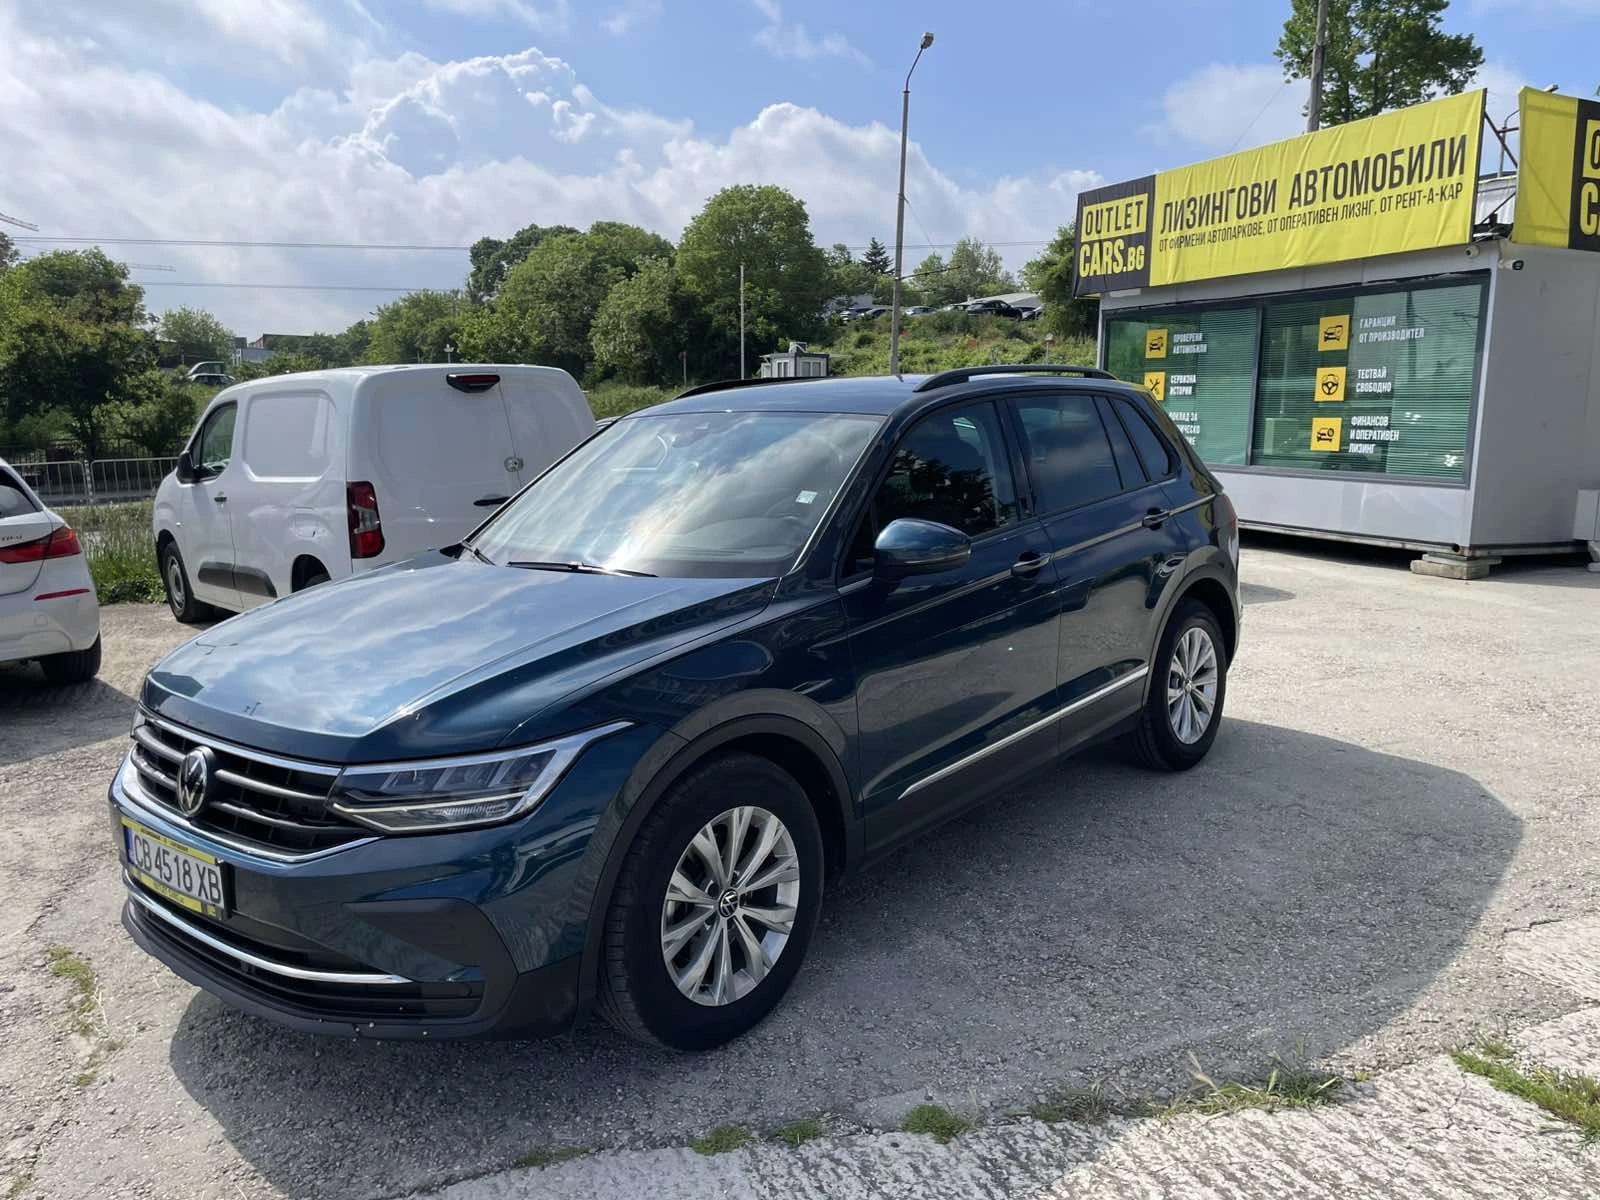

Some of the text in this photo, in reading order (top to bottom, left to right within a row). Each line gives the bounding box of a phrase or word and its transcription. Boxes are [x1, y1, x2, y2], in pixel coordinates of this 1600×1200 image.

[1160, 134, 1467, 234] ЛИЗИНГОВИ АВТОМОБИЛИ
[1084, 200, 1144, 236] OUTLET
[1159, 238, 1169, 252] ОТ
[1207, 220, 1266, 244] АВТОПАРКОВЕ,
[1267, 216, 1278, 234] ОТ
[1280, 206, 1338, 231] ОПЕРАТИВЕН
[1380, 194, 1394, 213] ОТ
[1396, 183, 1463, 209] РЕНТ-А-КАР
[1079, 239, 1145, 278] CARS.BG
[1360, 315, 1397, 329] ГАРАНЦИЯ
[1359, 327, 1425, 344] ОТ ПРОИЗВОДИТЕЛ
[1358, 366, 1387, 379] ТЕСТВАЙ
[1356, 382, 1392, 393] СВОБОДНО
[1351, 416, 1388, 426] ФИНАНСОВ
[1350, 429, 1399, 440] И ОПЕРАТИВЕН
